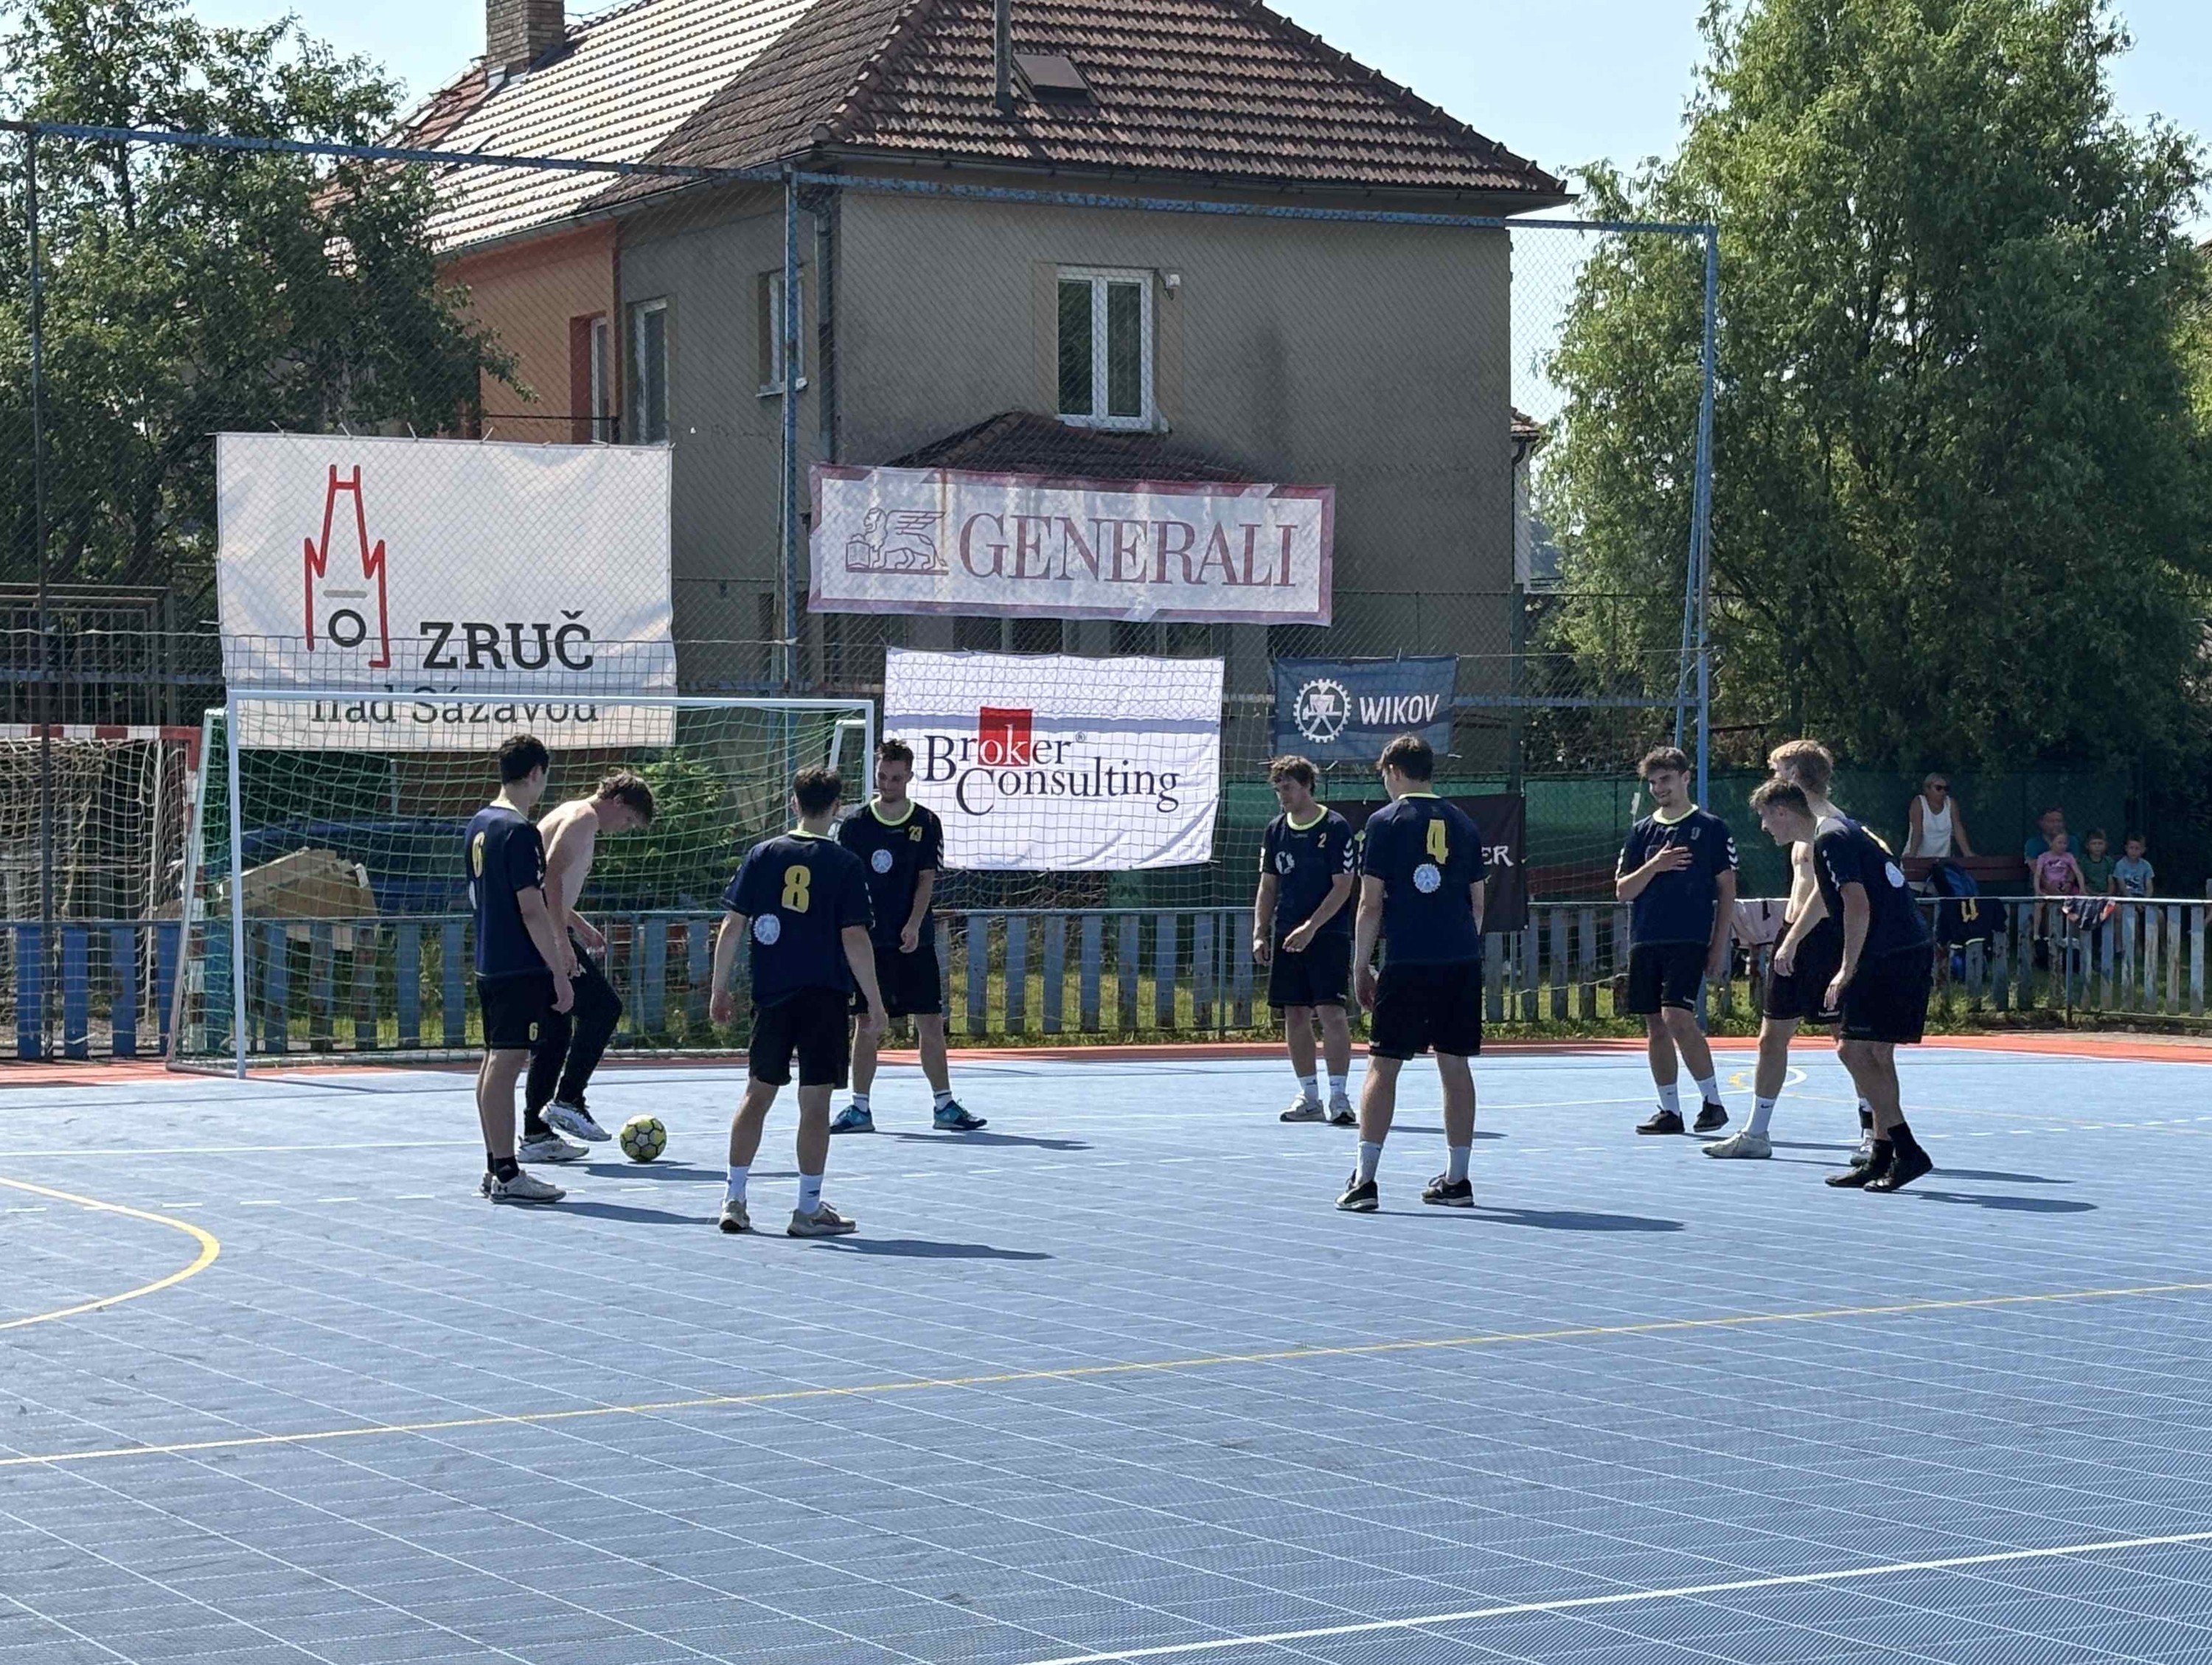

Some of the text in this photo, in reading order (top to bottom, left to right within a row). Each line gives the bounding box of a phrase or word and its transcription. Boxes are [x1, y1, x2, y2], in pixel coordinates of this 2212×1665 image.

[959, 512, 1298, 587] GENERALI
[420, 610, 594, 670] ZRUČ
[1359, 694, 1439, 725] WIKOV
[956, 757, 1180, 816] Consulting
[1317, 832, 1327, 848] 2
[1427, 818, 1449, 864] 4
[782, 864, 811, 914] 8
